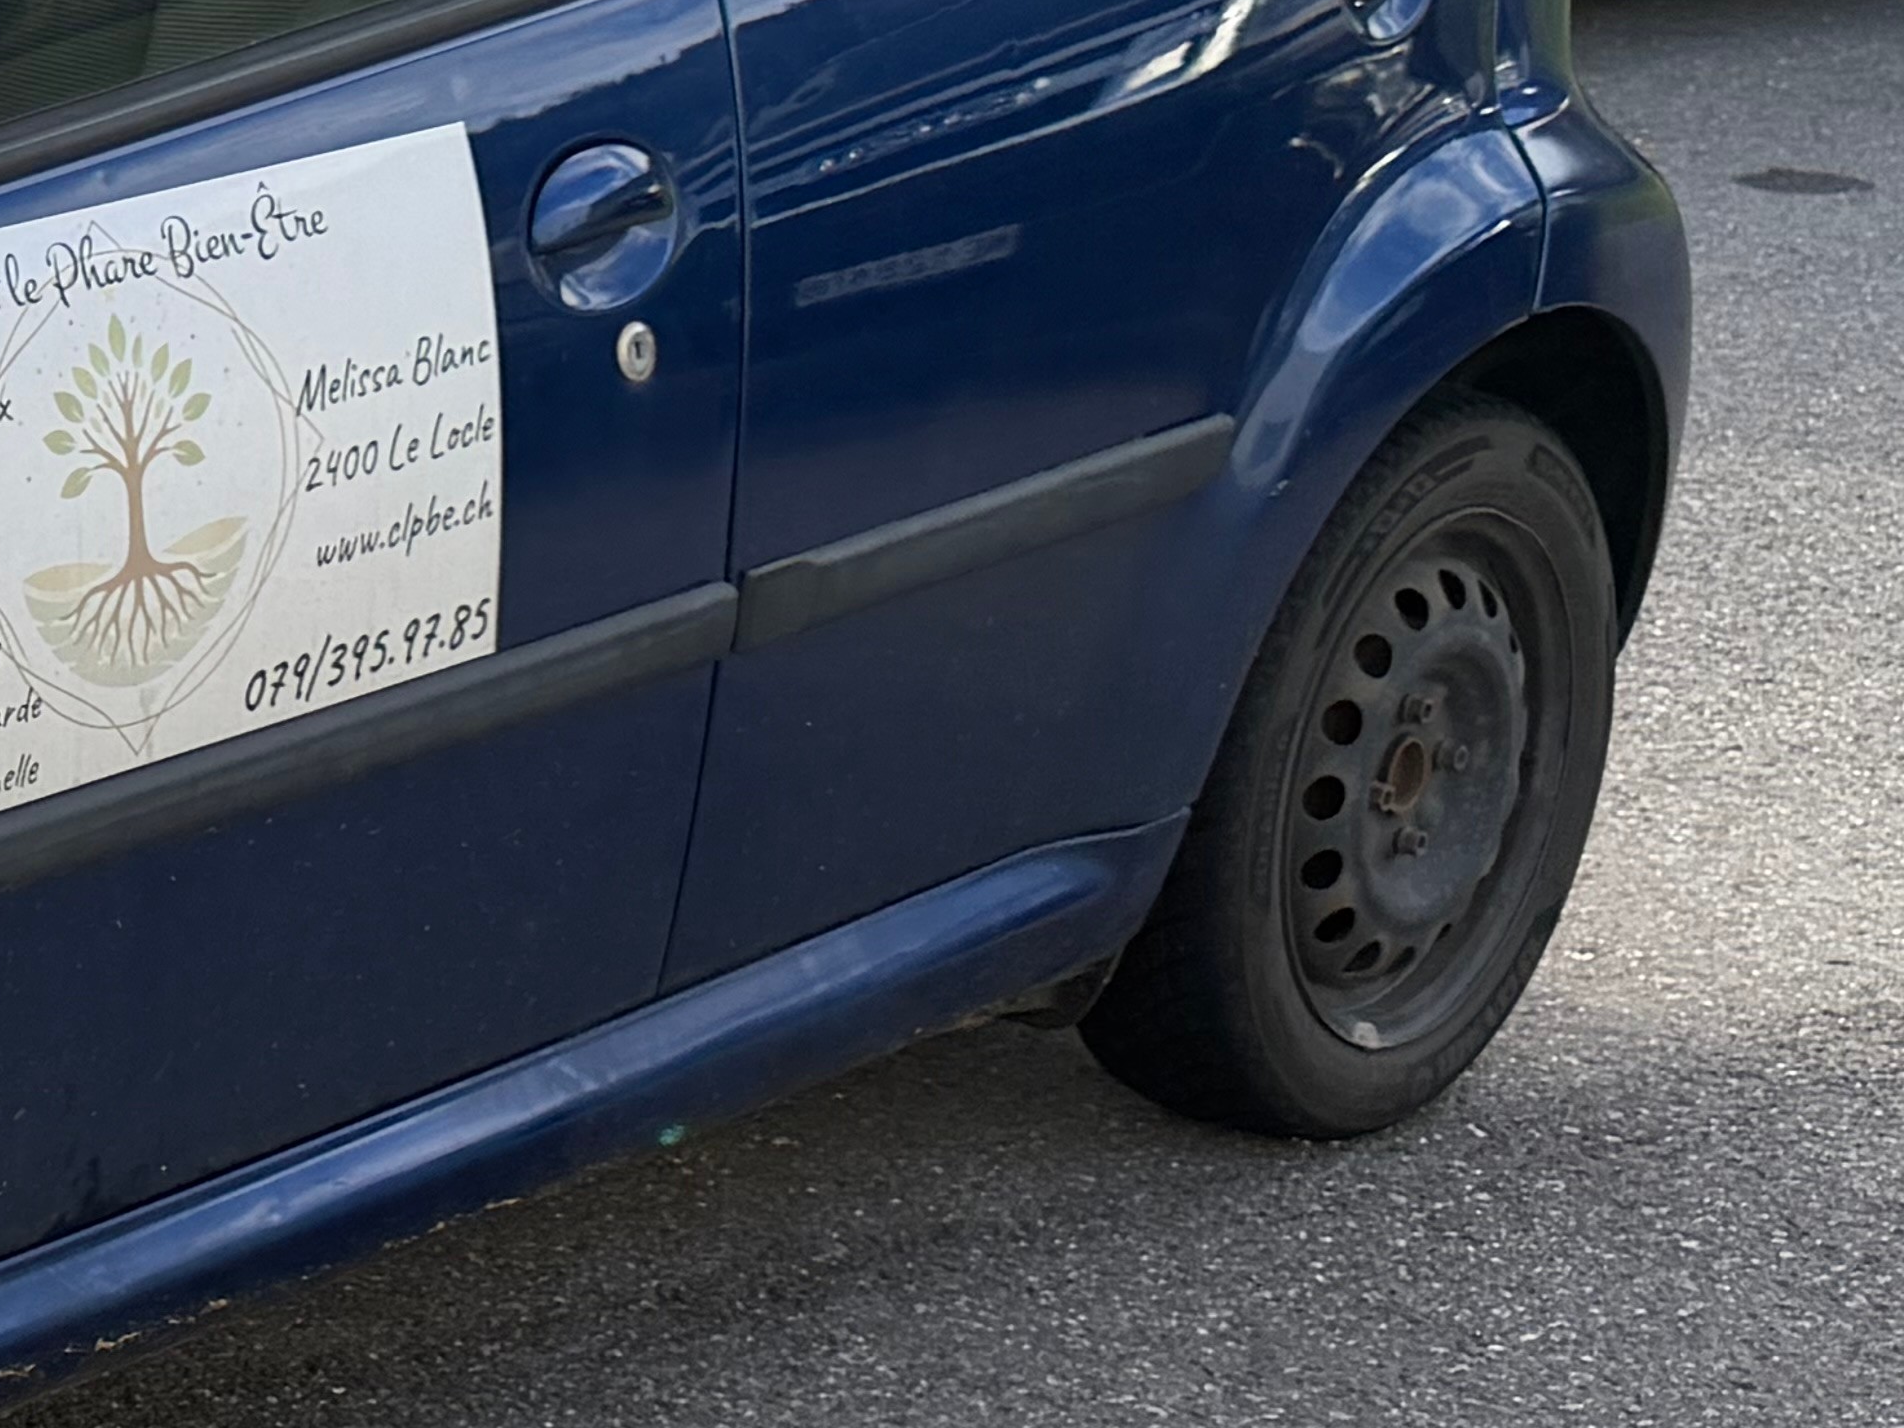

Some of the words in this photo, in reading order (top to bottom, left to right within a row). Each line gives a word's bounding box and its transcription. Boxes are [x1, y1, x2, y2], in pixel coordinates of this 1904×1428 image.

[5, 253, 42, 308] le
[45, 228, 156, 307] Phare
[160, 182, 328, 279] Bien-Être
[296, 357, 404, 417] Melissa
[411, 333, 492, 387] Blanc
[305, 440, 379, 492] 2400
[388, 423, 420, 471] Le
[429, 403, 495, 460] Locle
[315, 479, 495, 567] www.clpbe.ch
[244, 597, 492, 712] 079/395.97.85
